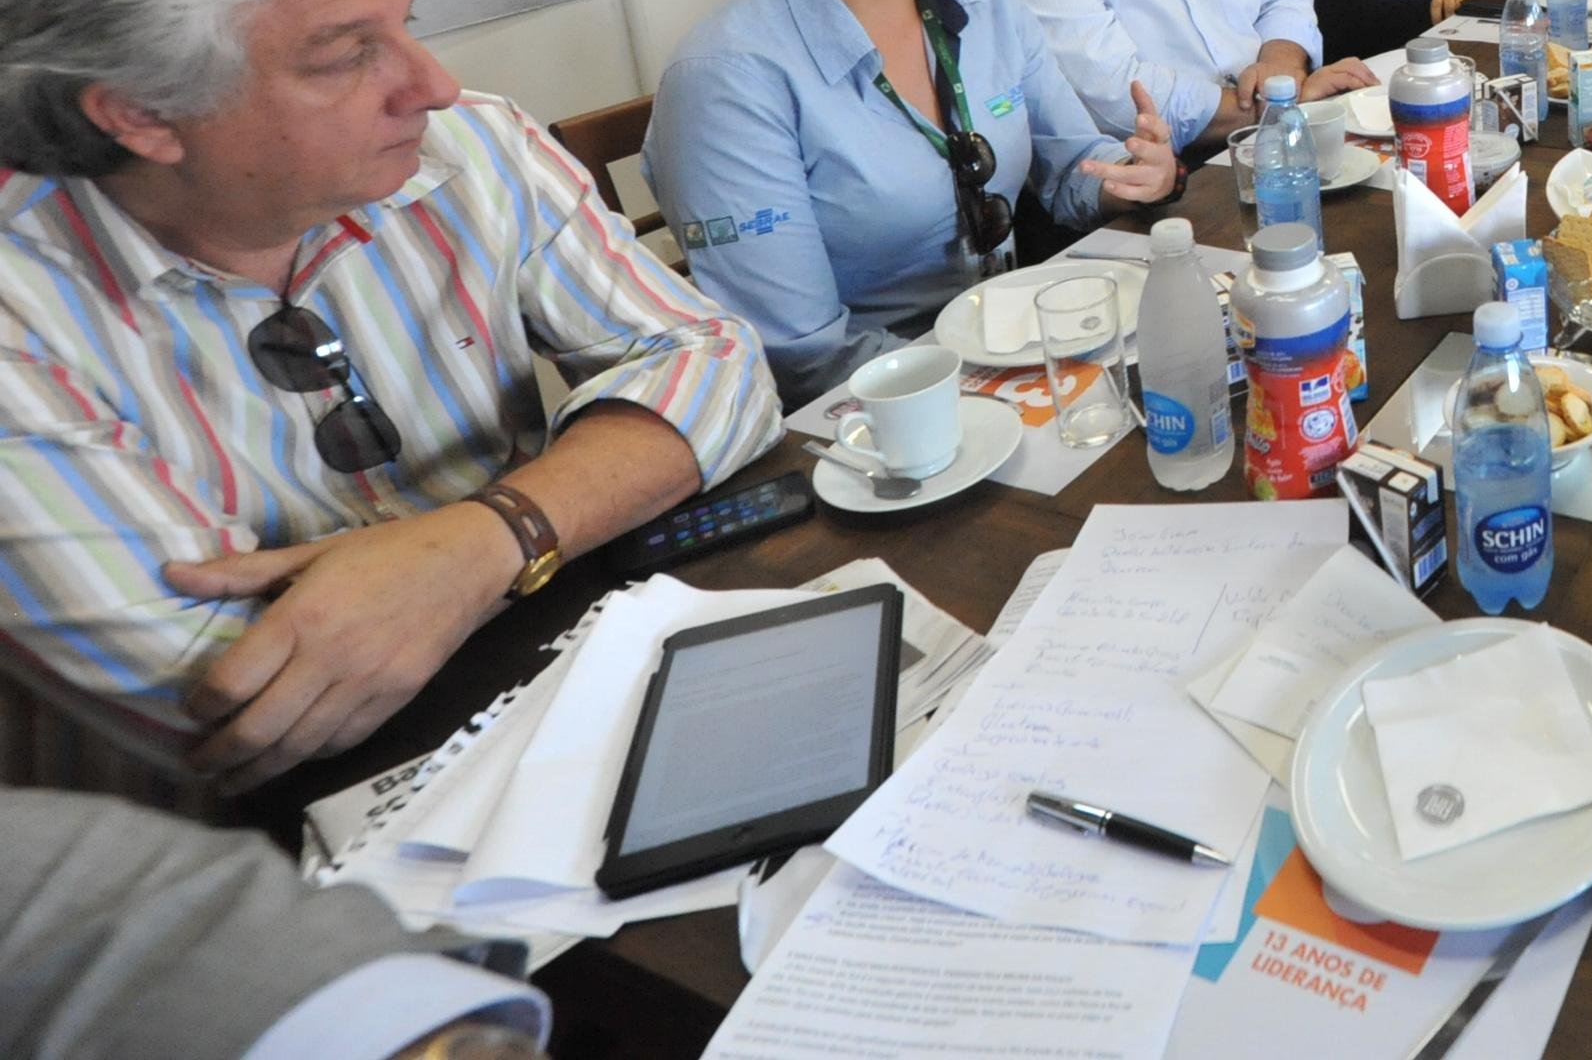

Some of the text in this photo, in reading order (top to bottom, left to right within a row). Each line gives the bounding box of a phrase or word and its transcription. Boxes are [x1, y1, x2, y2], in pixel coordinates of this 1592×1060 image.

[738, 211, 793, 233] SEBRAE
[1482, 518, 1544, 549] SCHIN
[1494, 547, 1537, 564] com gás
[1264, 930, 1388, 992] 13 ANOS DE
[1251, 953, 1368, 1012] LIDERANÇA
